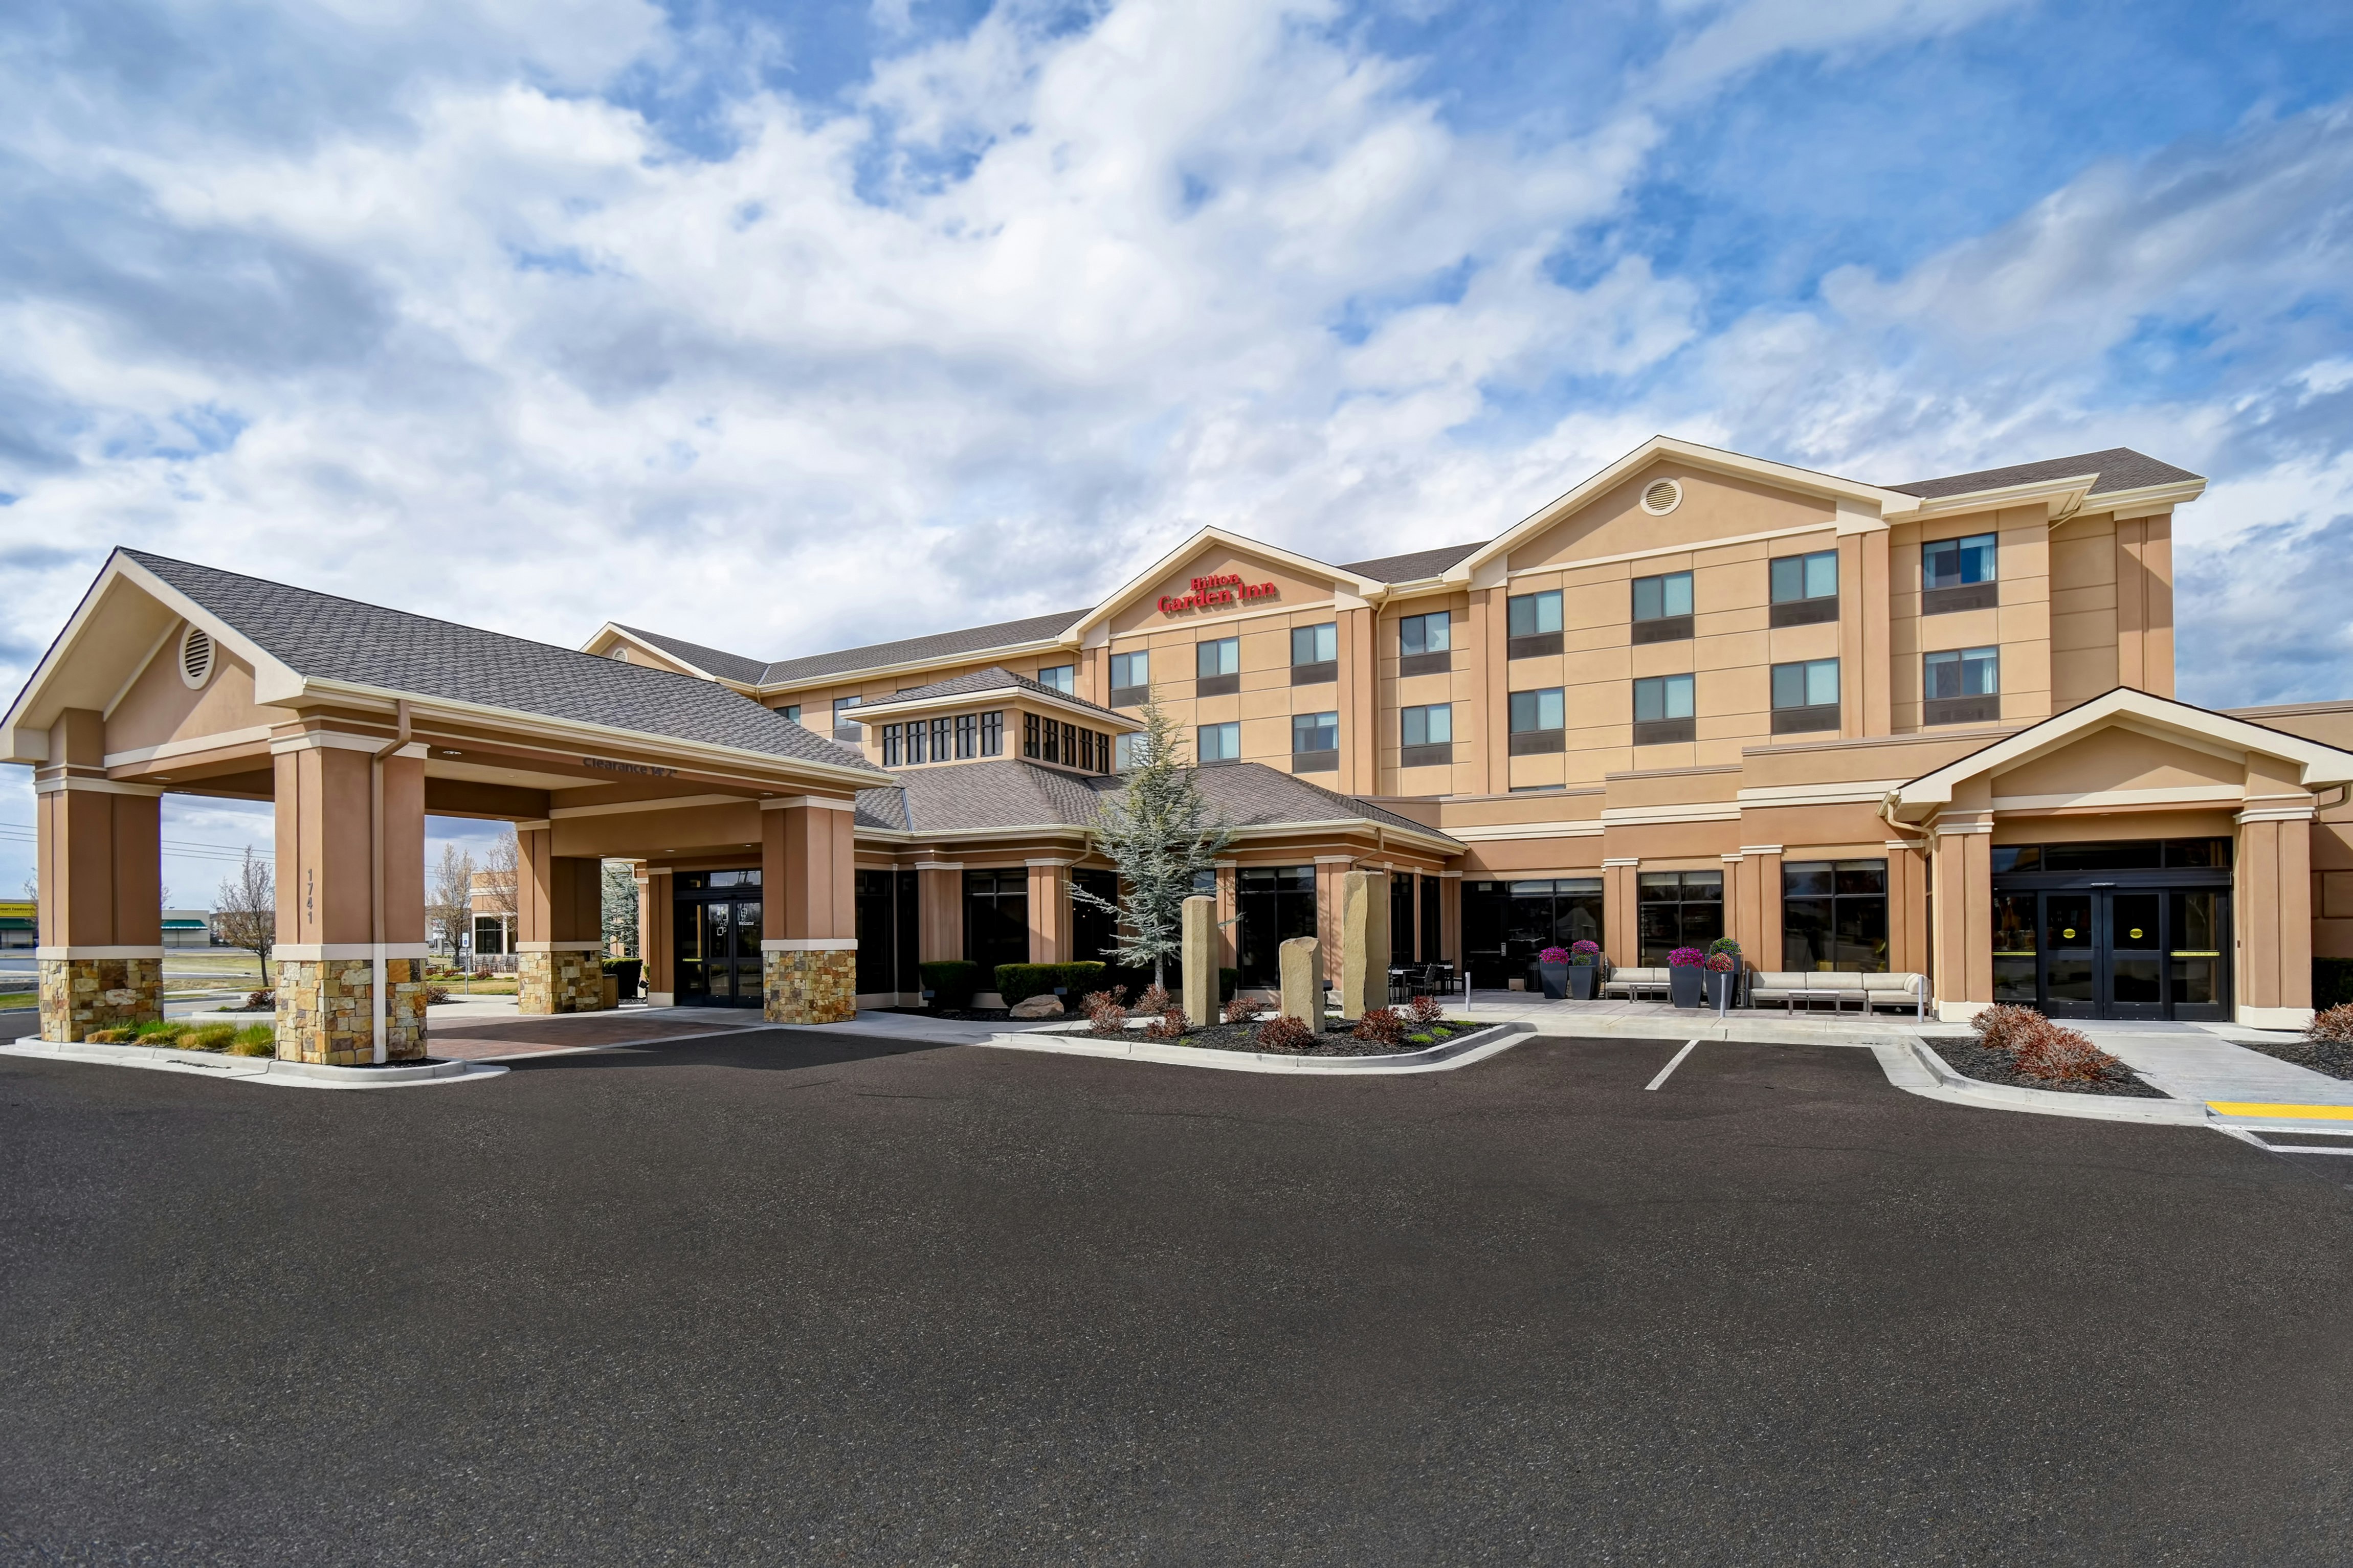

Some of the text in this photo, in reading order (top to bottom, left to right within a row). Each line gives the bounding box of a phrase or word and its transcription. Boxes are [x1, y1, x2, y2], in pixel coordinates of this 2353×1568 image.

[1191, 574, 1240, 590] Hilton
[1157, 581, 1276, 613] Garden Inn
[583, 757, 647, 774] Clearance
